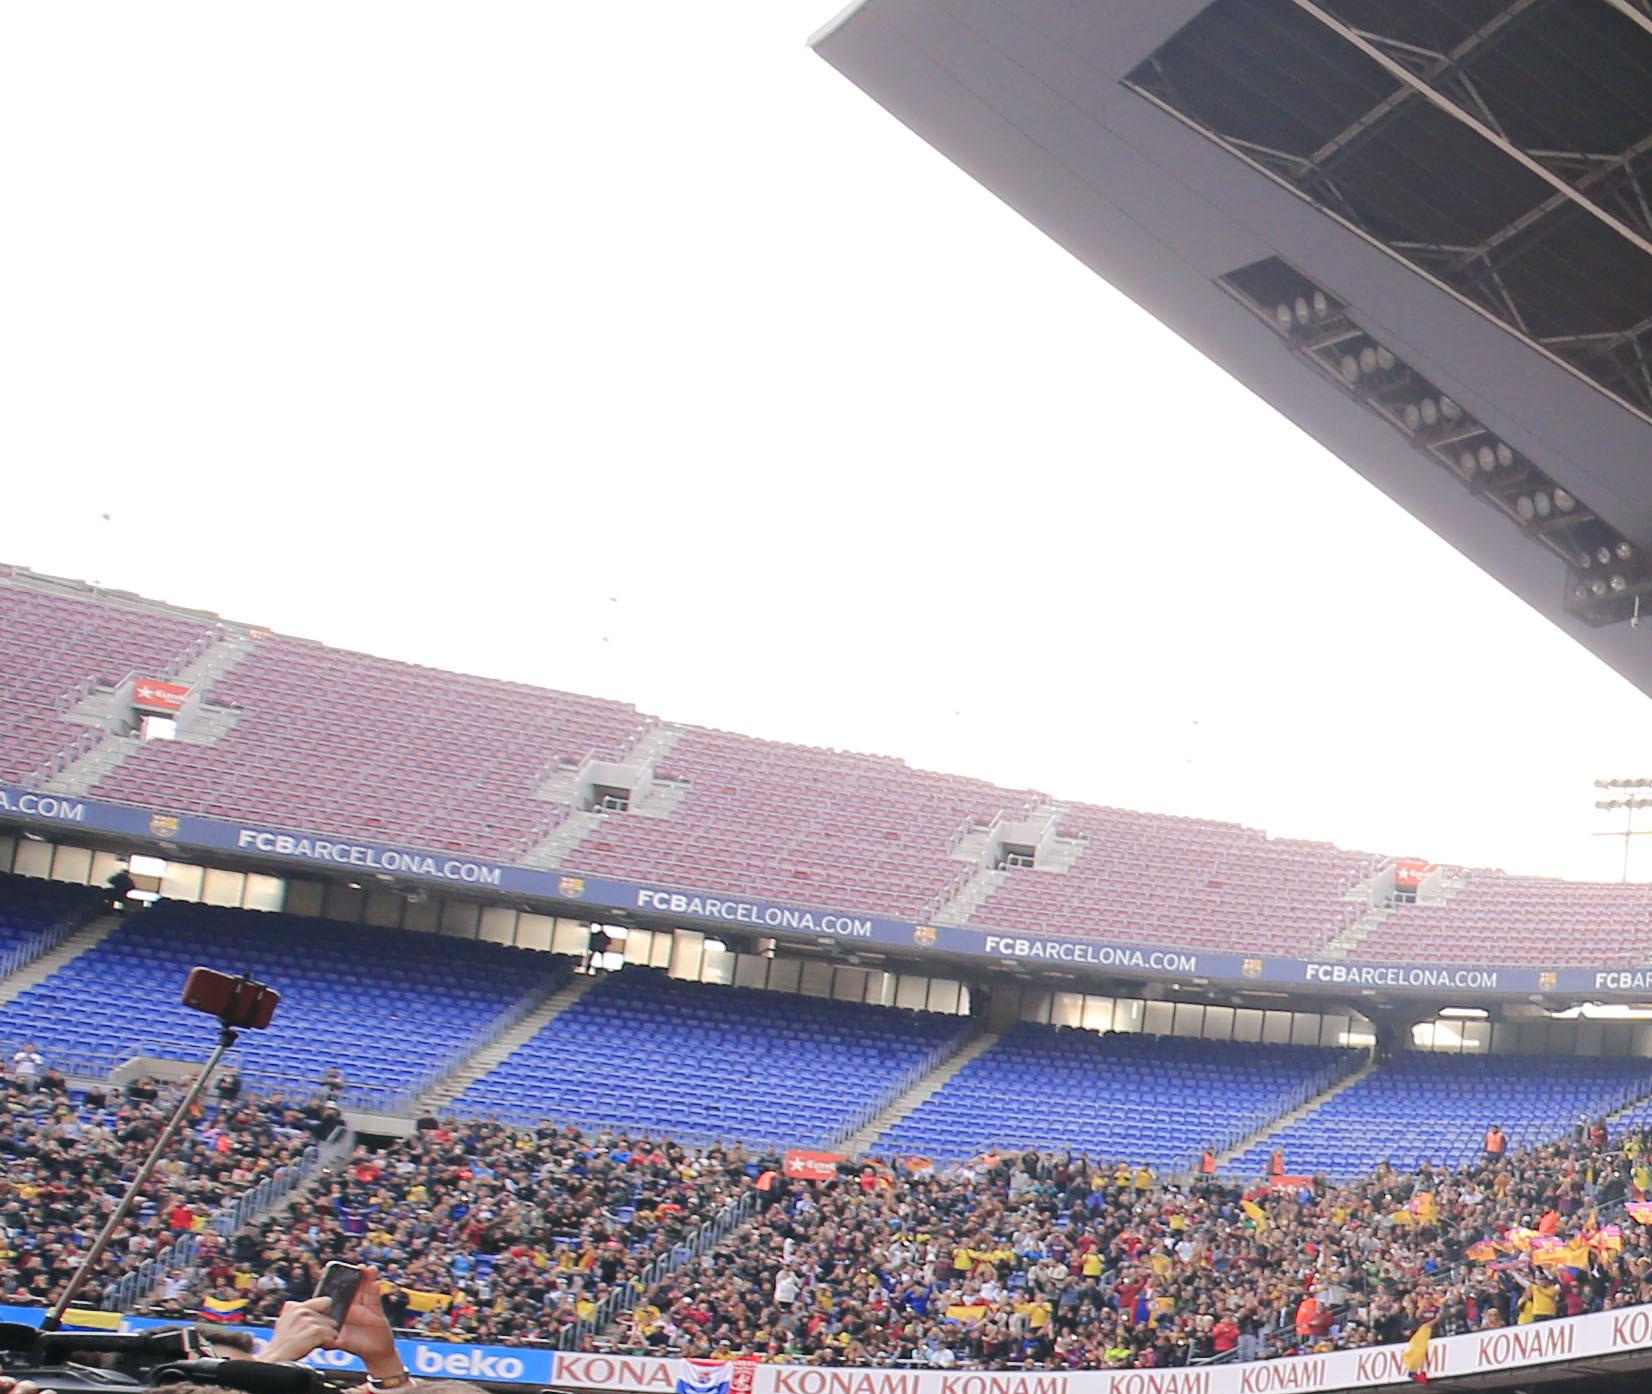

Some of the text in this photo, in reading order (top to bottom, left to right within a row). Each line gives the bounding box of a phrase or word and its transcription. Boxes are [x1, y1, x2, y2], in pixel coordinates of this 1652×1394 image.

[237, 829, 502, 885] FCBARCELONA.COM
[637, 889, 873, 938] FCBARCELONA.COM
[985, 935, 1197, 972] FCBARCELONA.COM
[1306, 963, 1498, 989] FCBARCELONA.COM
[415, 1345, 524, 1379] beko
[1356, 1343, 1447, 1382] KONMI
[1477, 1325, 1575, 1367] KONAMI
[554, 1352, 674, 1389] KONA
